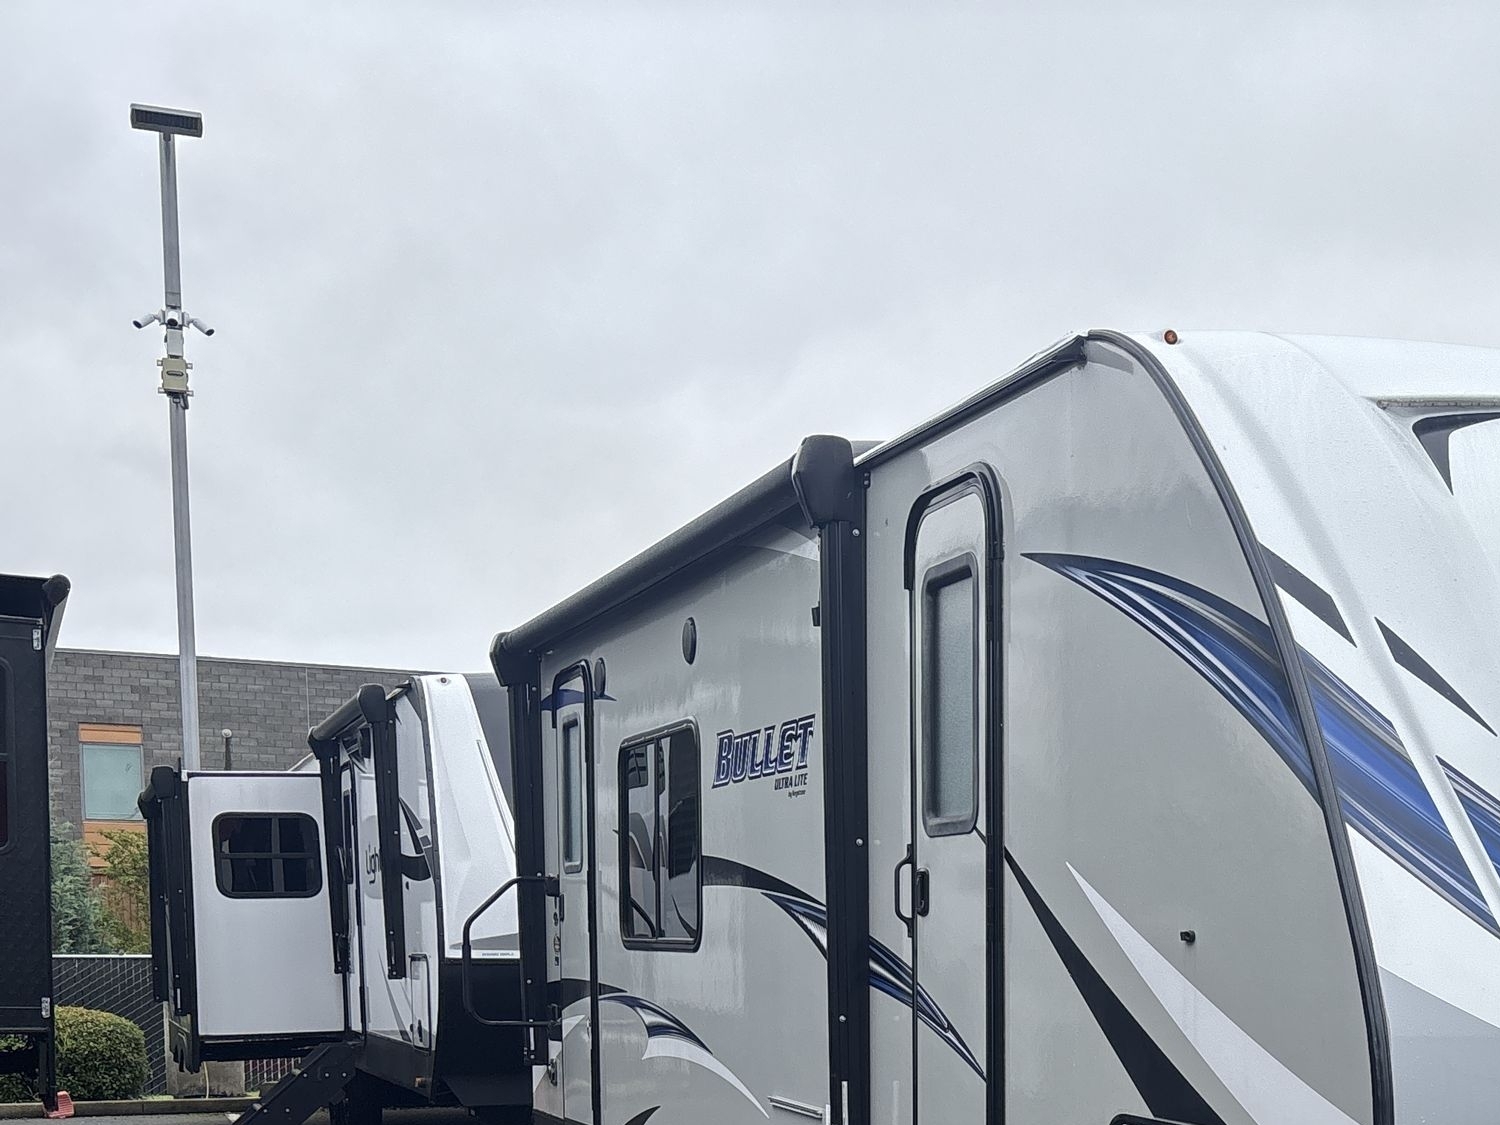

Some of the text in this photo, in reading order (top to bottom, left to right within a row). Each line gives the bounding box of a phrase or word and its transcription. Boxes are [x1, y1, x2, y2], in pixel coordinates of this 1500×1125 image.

[711, 713, 816, 789] BULLET
[774, 772, 808, 791] ULTRA LITE
